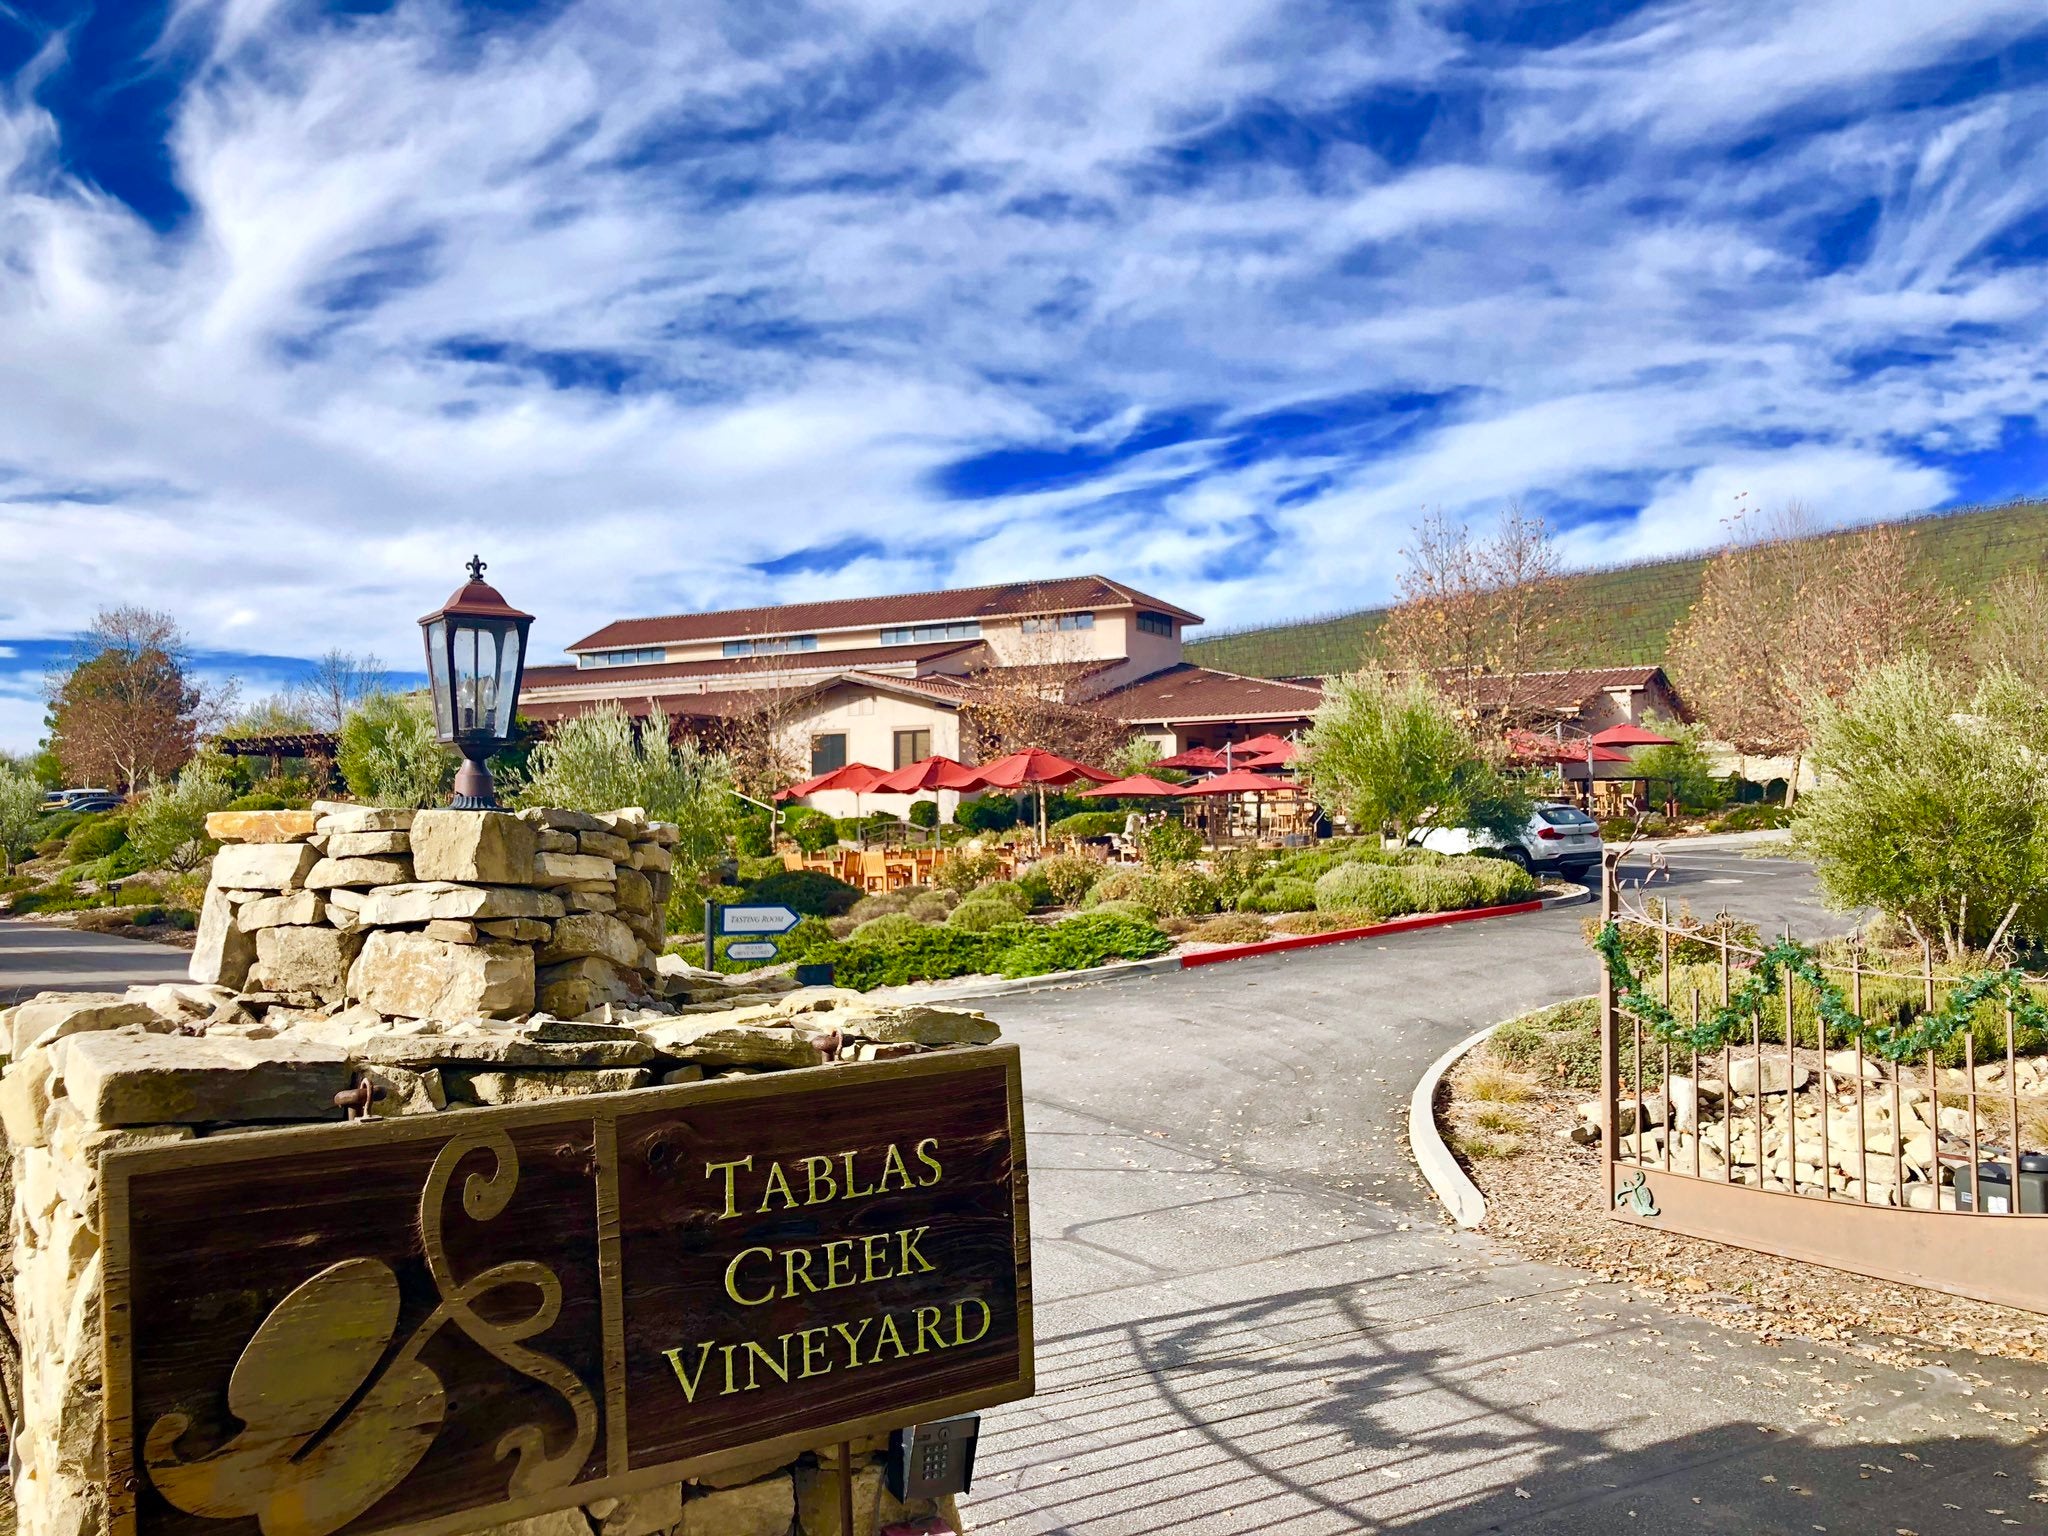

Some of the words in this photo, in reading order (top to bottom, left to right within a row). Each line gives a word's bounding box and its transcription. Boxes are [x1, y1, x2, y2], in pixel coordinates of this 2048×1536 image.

[730, 915, 760, 924] TASTING
[761, 914, 784, 923] ROOM
[704, 1137, 944, 1221] TABLAS
[723, 1225, 937, 1306] CREEK
[660, 1296, 992, 1403] VINEYARD
